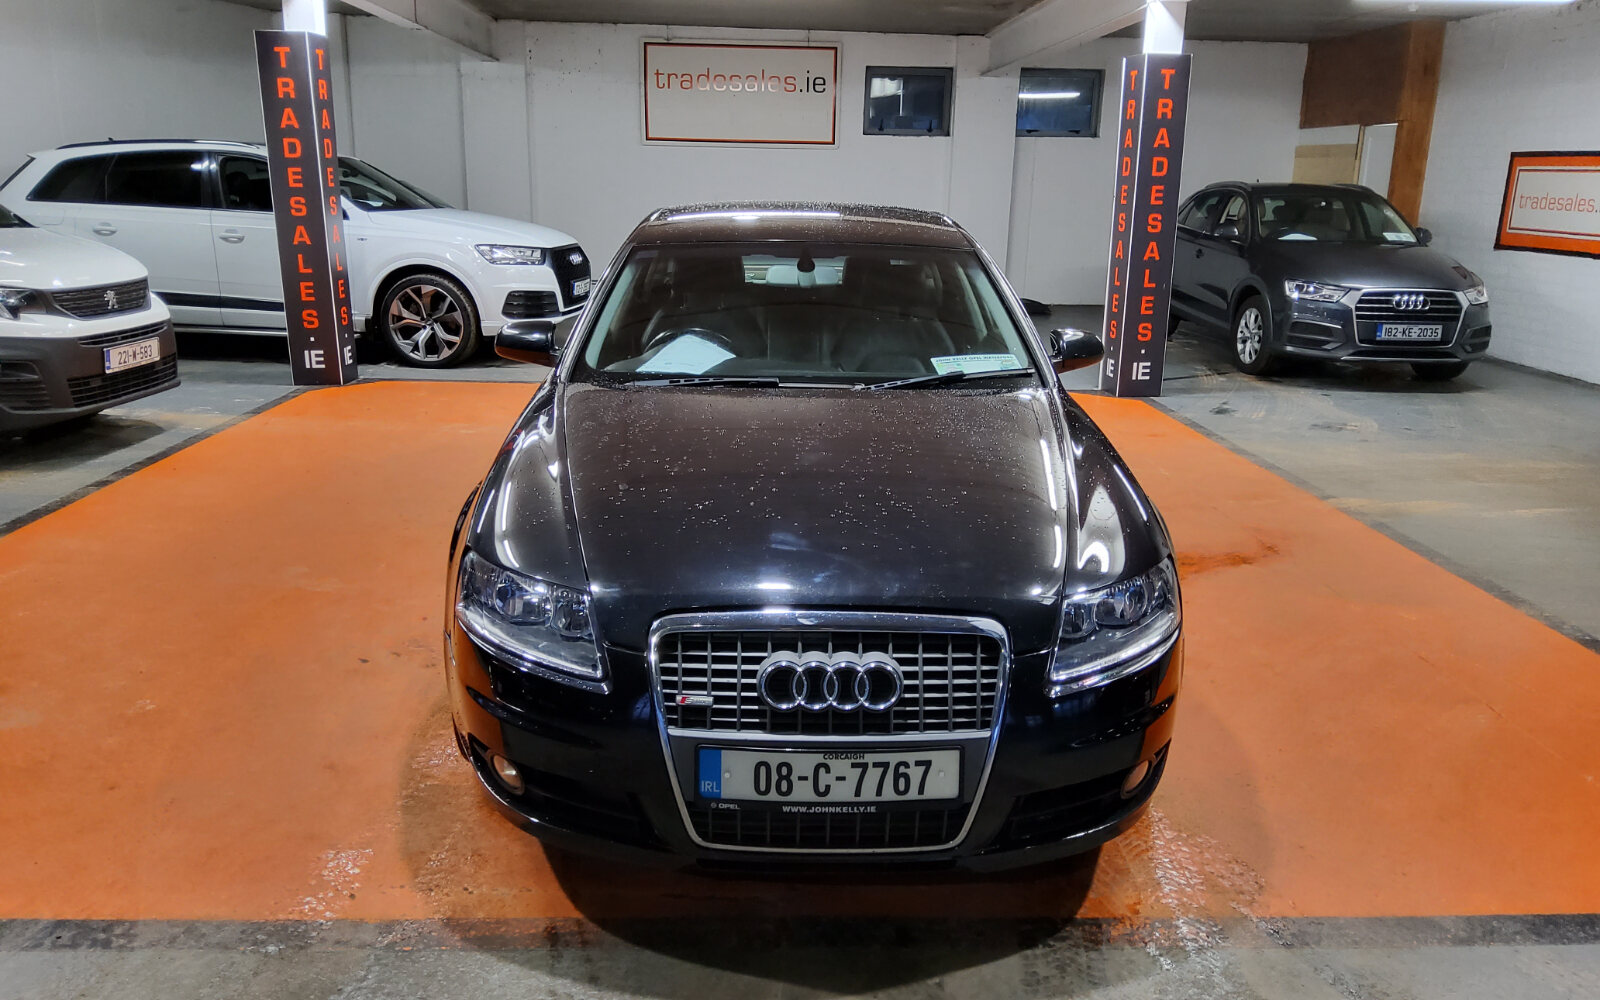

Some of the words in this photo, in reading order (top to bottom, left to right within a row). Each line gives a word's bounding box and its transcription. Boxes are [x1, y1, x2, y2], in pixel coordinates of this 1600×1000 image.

[653, 67, 827, 94] tradesales.ie
[1518, 192, 1600, 213] tradesales.
[1384, 327, 1440, 338] 182-KE-2035
[117, 344, 153, 365] 221-W-583
[701, 780, 720, 793] IRL
[753, 759, 933, 798] 08-C-7767
[782, 805, 877, 814] WWW.JOHNKELLY.IE
